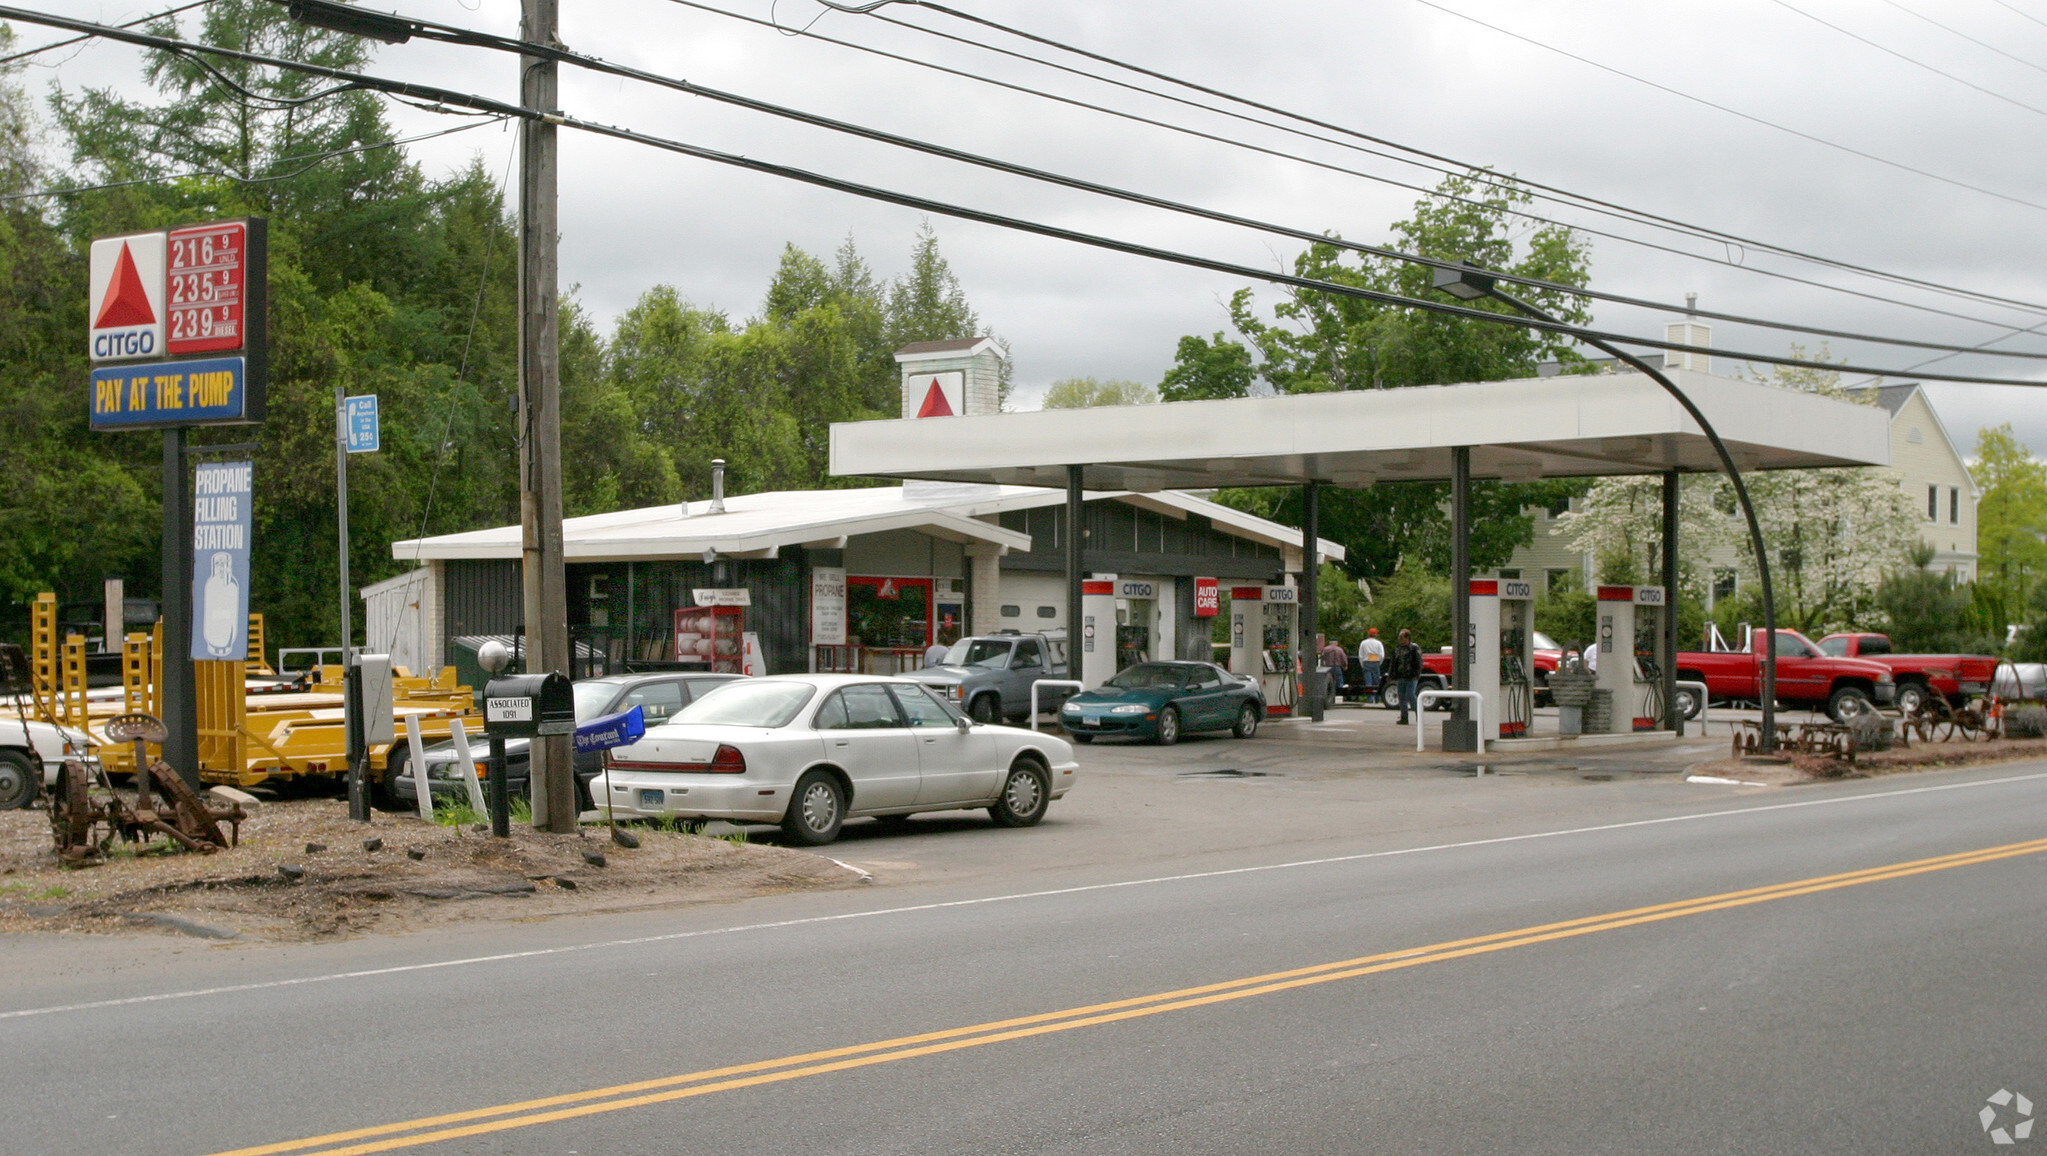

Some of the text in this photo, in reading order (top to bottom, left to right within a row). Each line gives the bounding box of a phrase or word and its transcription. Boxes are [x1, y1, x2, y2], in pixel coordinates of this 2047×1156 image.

[173, 234, 229, 268] 216 9
[172, 270, 230, 303] 235 9
[172, 306, 229, 338] 239 9
[214, 325, 235, 336] DIESEL
[95, 329, 154, 357] CITGO
[95, 370, 234, 413] PAY AT THE PUMP
[195, 467, 251, 493] PROPANE
[195, 497, 237, 522] FILLING
[194, 524, 243, 550] STATION
[815, 584, 844, 598] PROPANE
[1123, 583, 1152, 596] CITGO
[1198, 586, 1217, 598] AUTO
[1269, 589, 1293, 600] CITGO
[1506, 582, 1530, 596] CITGO
[1640, 589, 1661, 601] CITGO
[1198, 597, 1218, 609] CARE
[490, 699, 530, 709] ASSOCIATED
[502, 710, 517, 719] 1091
[575, 735, 590, 747] The
